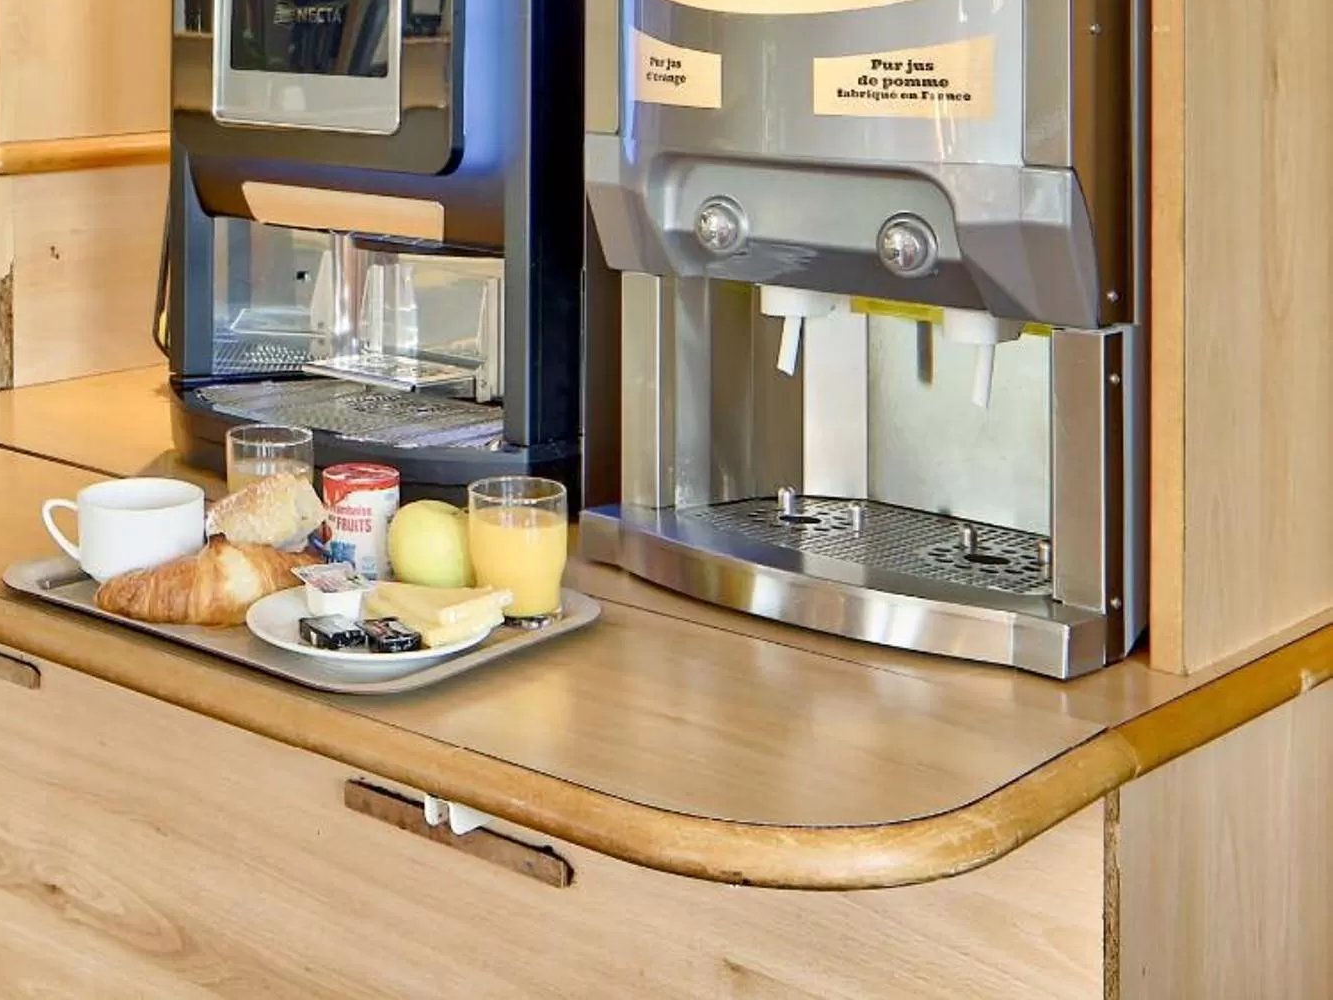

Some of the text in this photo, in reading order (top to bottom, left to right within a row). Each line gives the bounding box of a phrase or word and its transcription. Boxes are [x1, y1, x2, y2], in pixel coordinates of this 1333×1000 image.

[870, 58, 934, 74] Pur jus
[857, 75, 950, 90] de pomme
[900, 92, 918, 100] en
[336, 517, 373, 533] FRUITS
